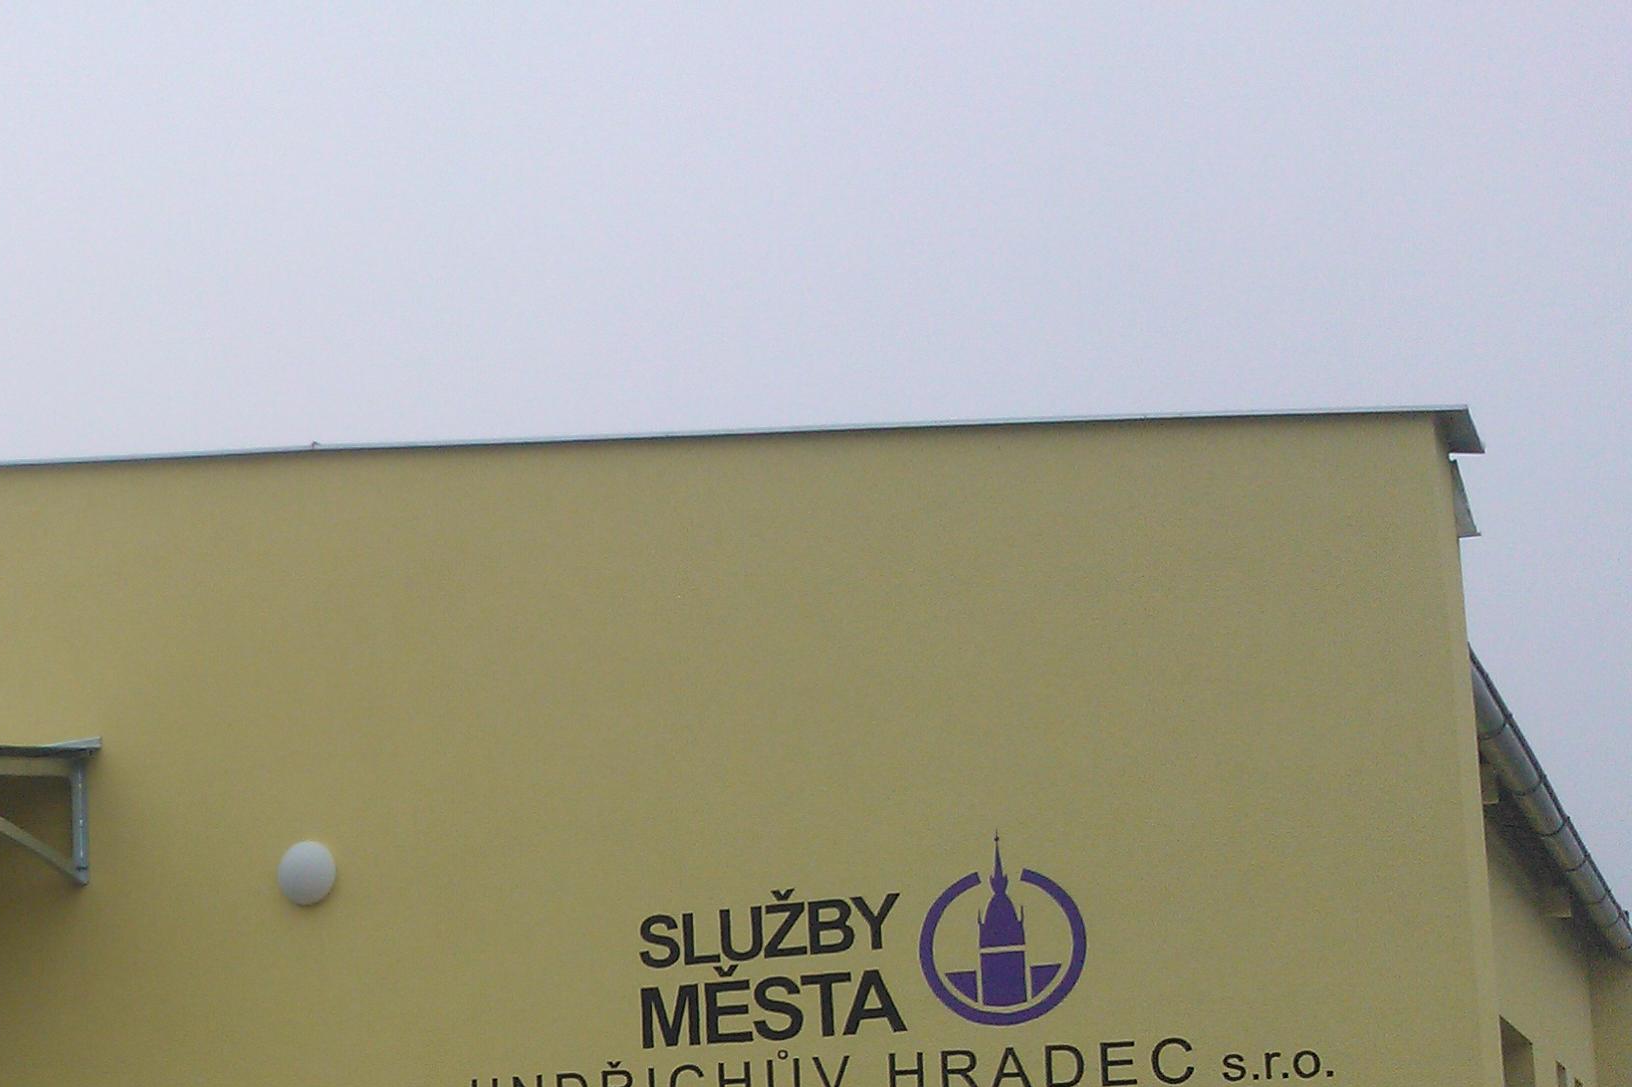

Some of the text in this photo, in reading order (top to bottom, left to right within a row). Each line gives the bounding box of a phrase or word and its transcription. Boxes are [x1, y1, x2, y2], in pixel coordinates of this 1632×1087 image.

[638, 887, 901, 969] SLUŽBY
[640, 963, 909, 1050] MĚSTA
[1221, 1049, 1335, 1083] s.r.o.
